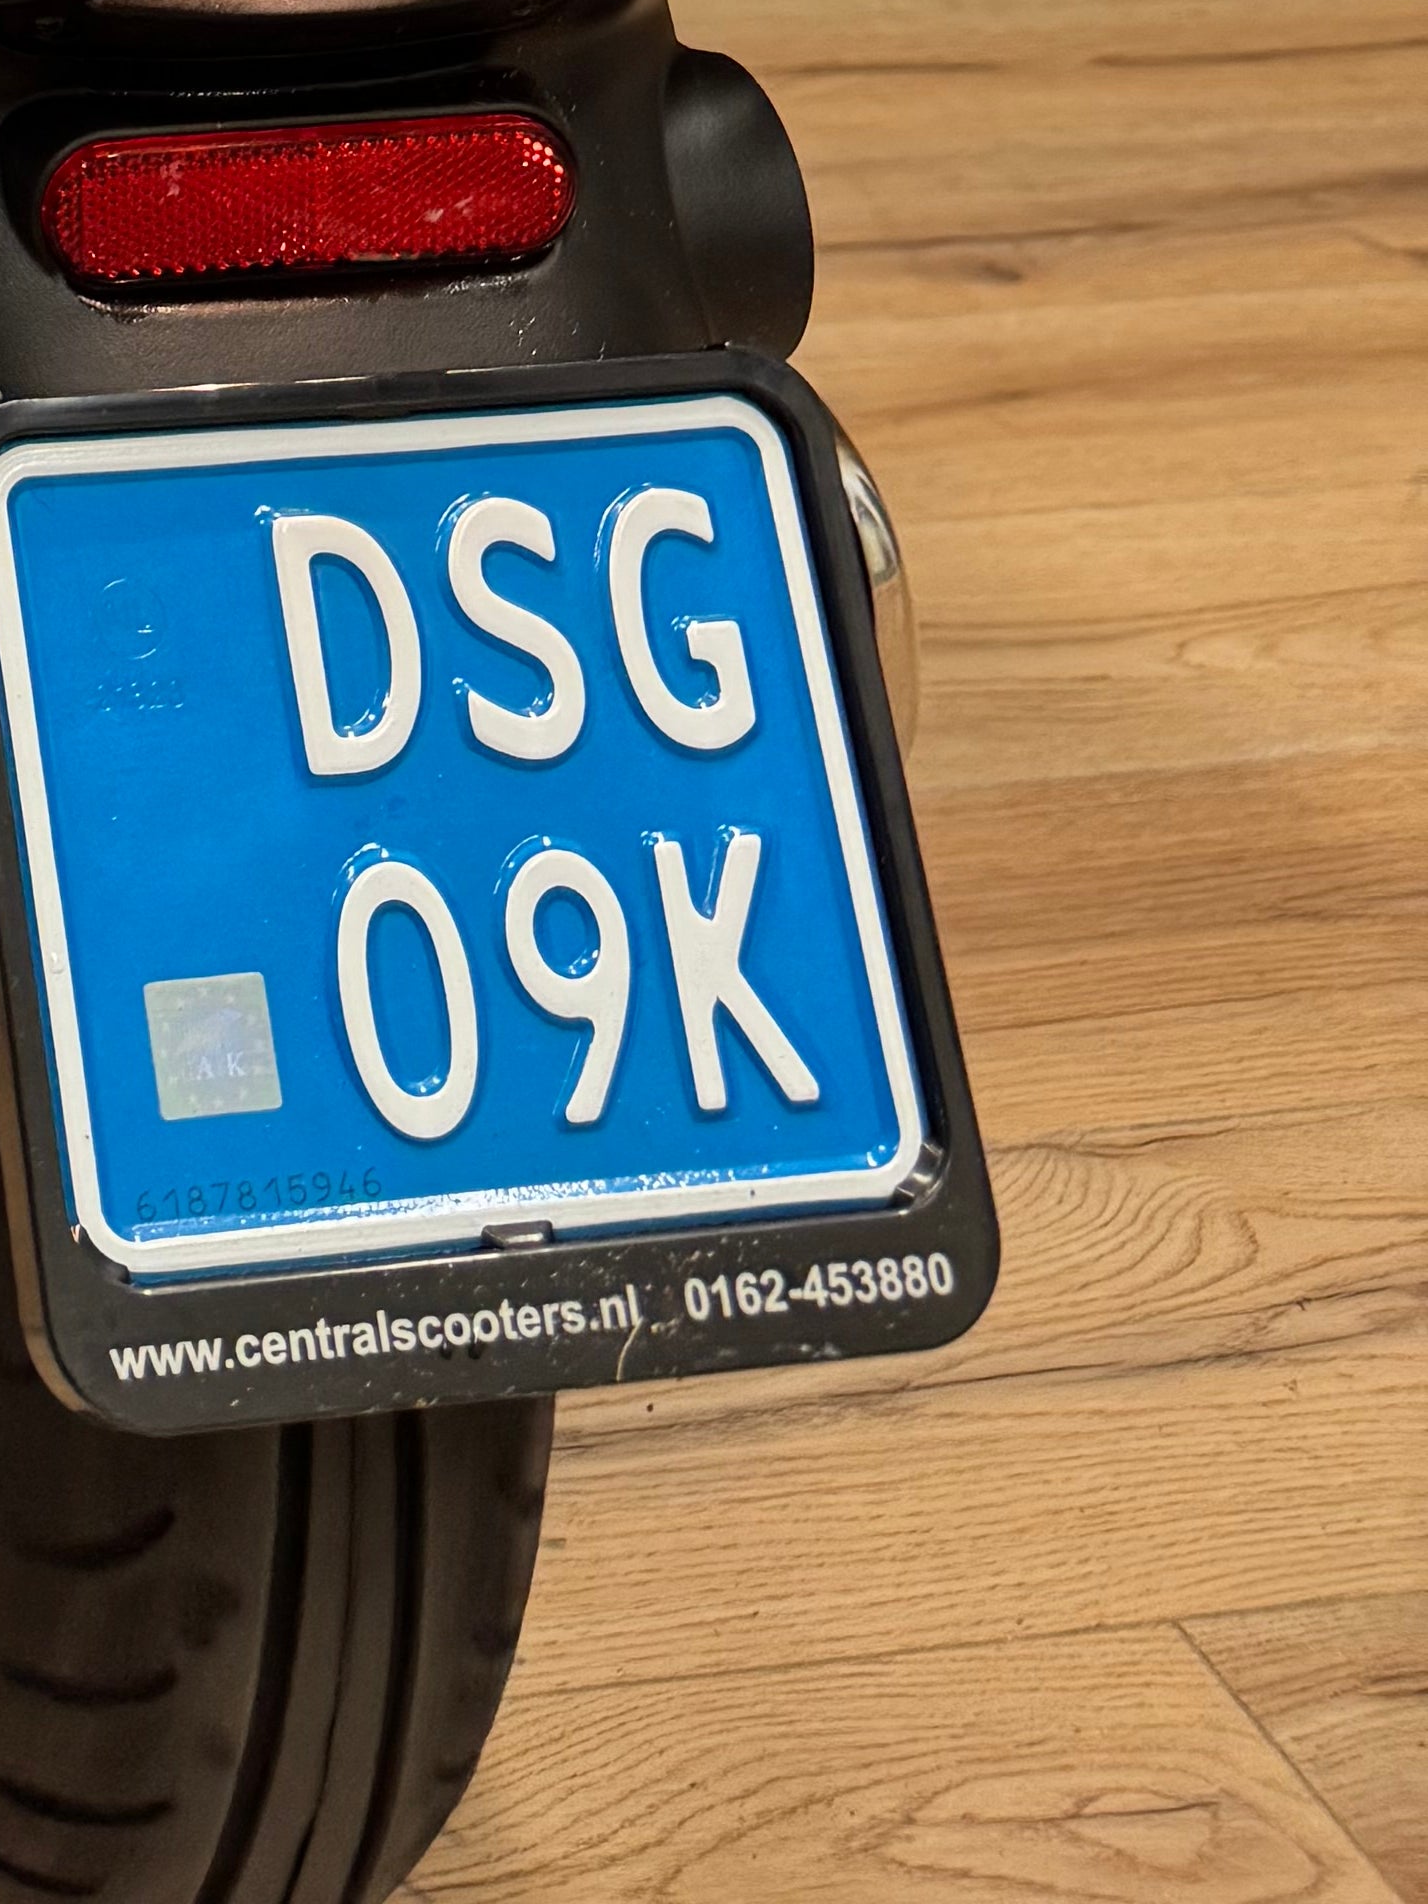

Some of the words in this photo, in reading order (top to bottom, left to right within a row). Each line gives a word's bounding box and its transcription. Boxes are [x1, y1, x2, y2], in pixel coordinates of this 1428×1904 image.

[271, 488, 756, 777] DSG
[337, 832, 820, 1140] 09K
[136, 1166, 383, 1223] 6187815946
[109, 1284, 641, 1380] www.centralscooters.nl
[684, 1251, 956, 1322] 0162-453880
